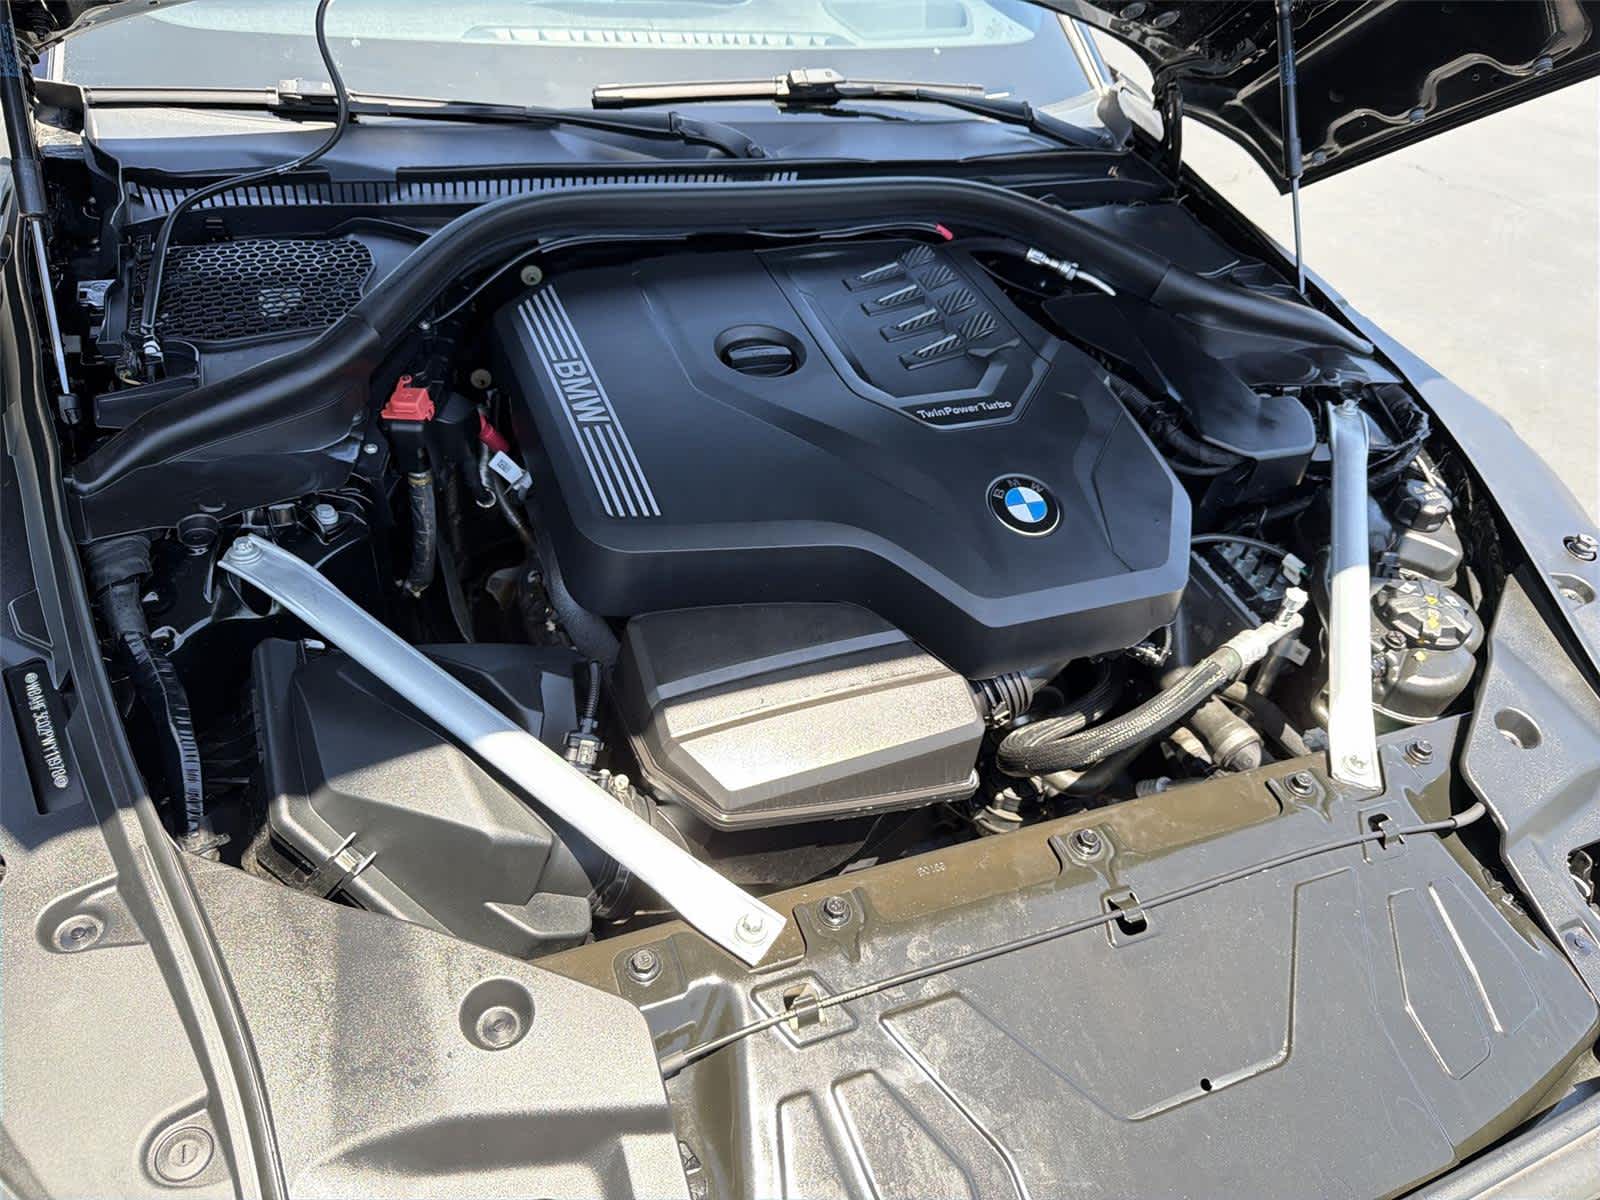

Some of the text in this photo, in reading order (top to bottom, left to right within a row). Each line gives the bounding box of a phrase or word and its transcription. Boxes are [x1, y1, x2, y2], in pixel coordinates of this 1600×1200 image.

[553, 360, 611, 421] BMW
[917, 401, 1012, 418] TwinPowerTurbo
[993, 480, 1044, 499] BMW
